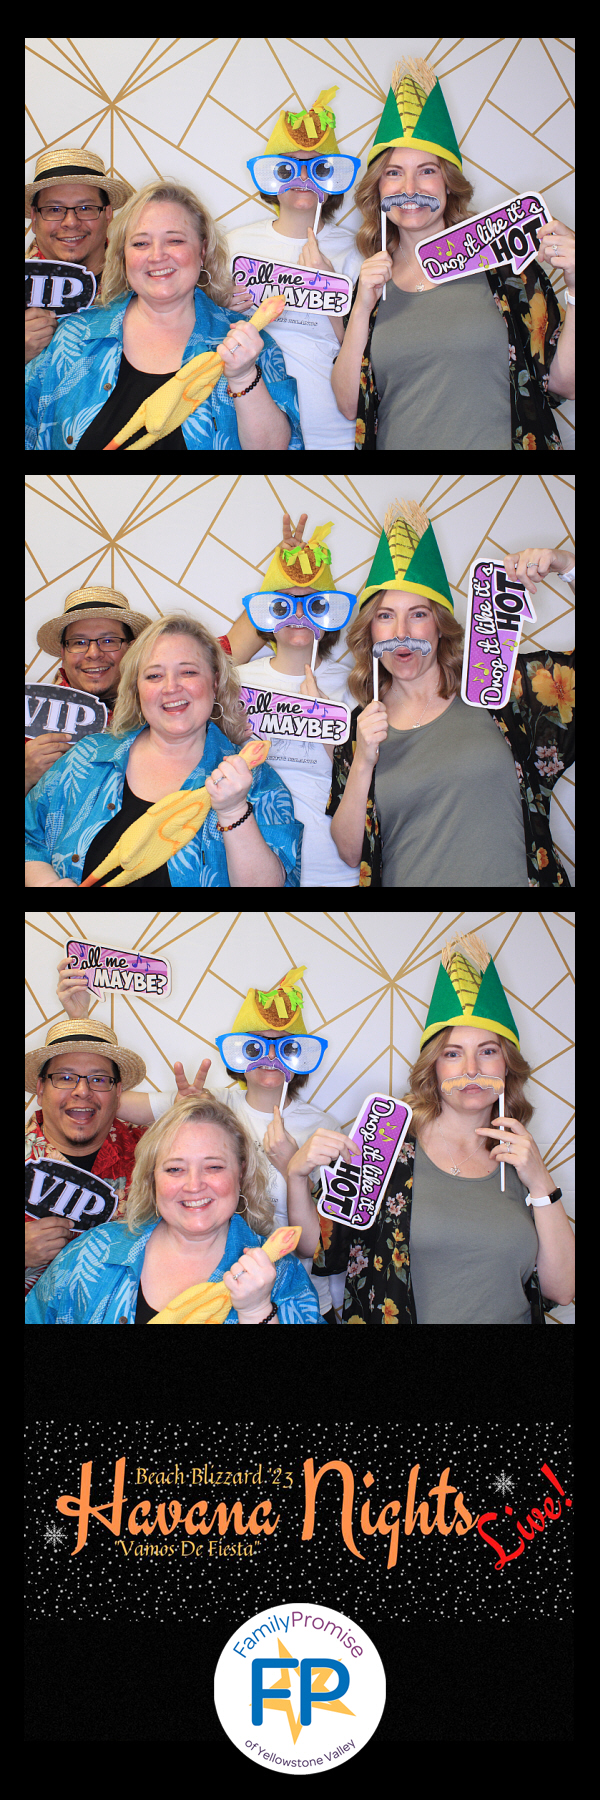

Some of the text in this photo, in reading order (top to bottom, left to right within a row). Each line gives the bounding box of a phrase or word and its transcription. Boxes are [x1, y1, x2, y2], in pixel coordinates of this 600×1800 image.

[422, 199, 545, 278] Drop it like it's
[490, 215, 543, 263] HOT
[25, 273, 84, 308] IP
[260, 284, 349, 313] MAYBE?
[278, 273, 304, 286] me
[495, 570, 527, 632] HOT
[471, 562, 508, 706] Drop it like it's
[25, 694, 96, 735] VIP
[259, 713, 348, 741] MAYBE?
[276, 702, 303, 714] me
[93, 967, 168, 995] MAYBE?
[105, 956, 128, 968] me
[351, 1100, 396, 1226] Drop it like it's
[28, 1168, 106, 1222] VIP
[324, 1161, 361, 1218] HOT
